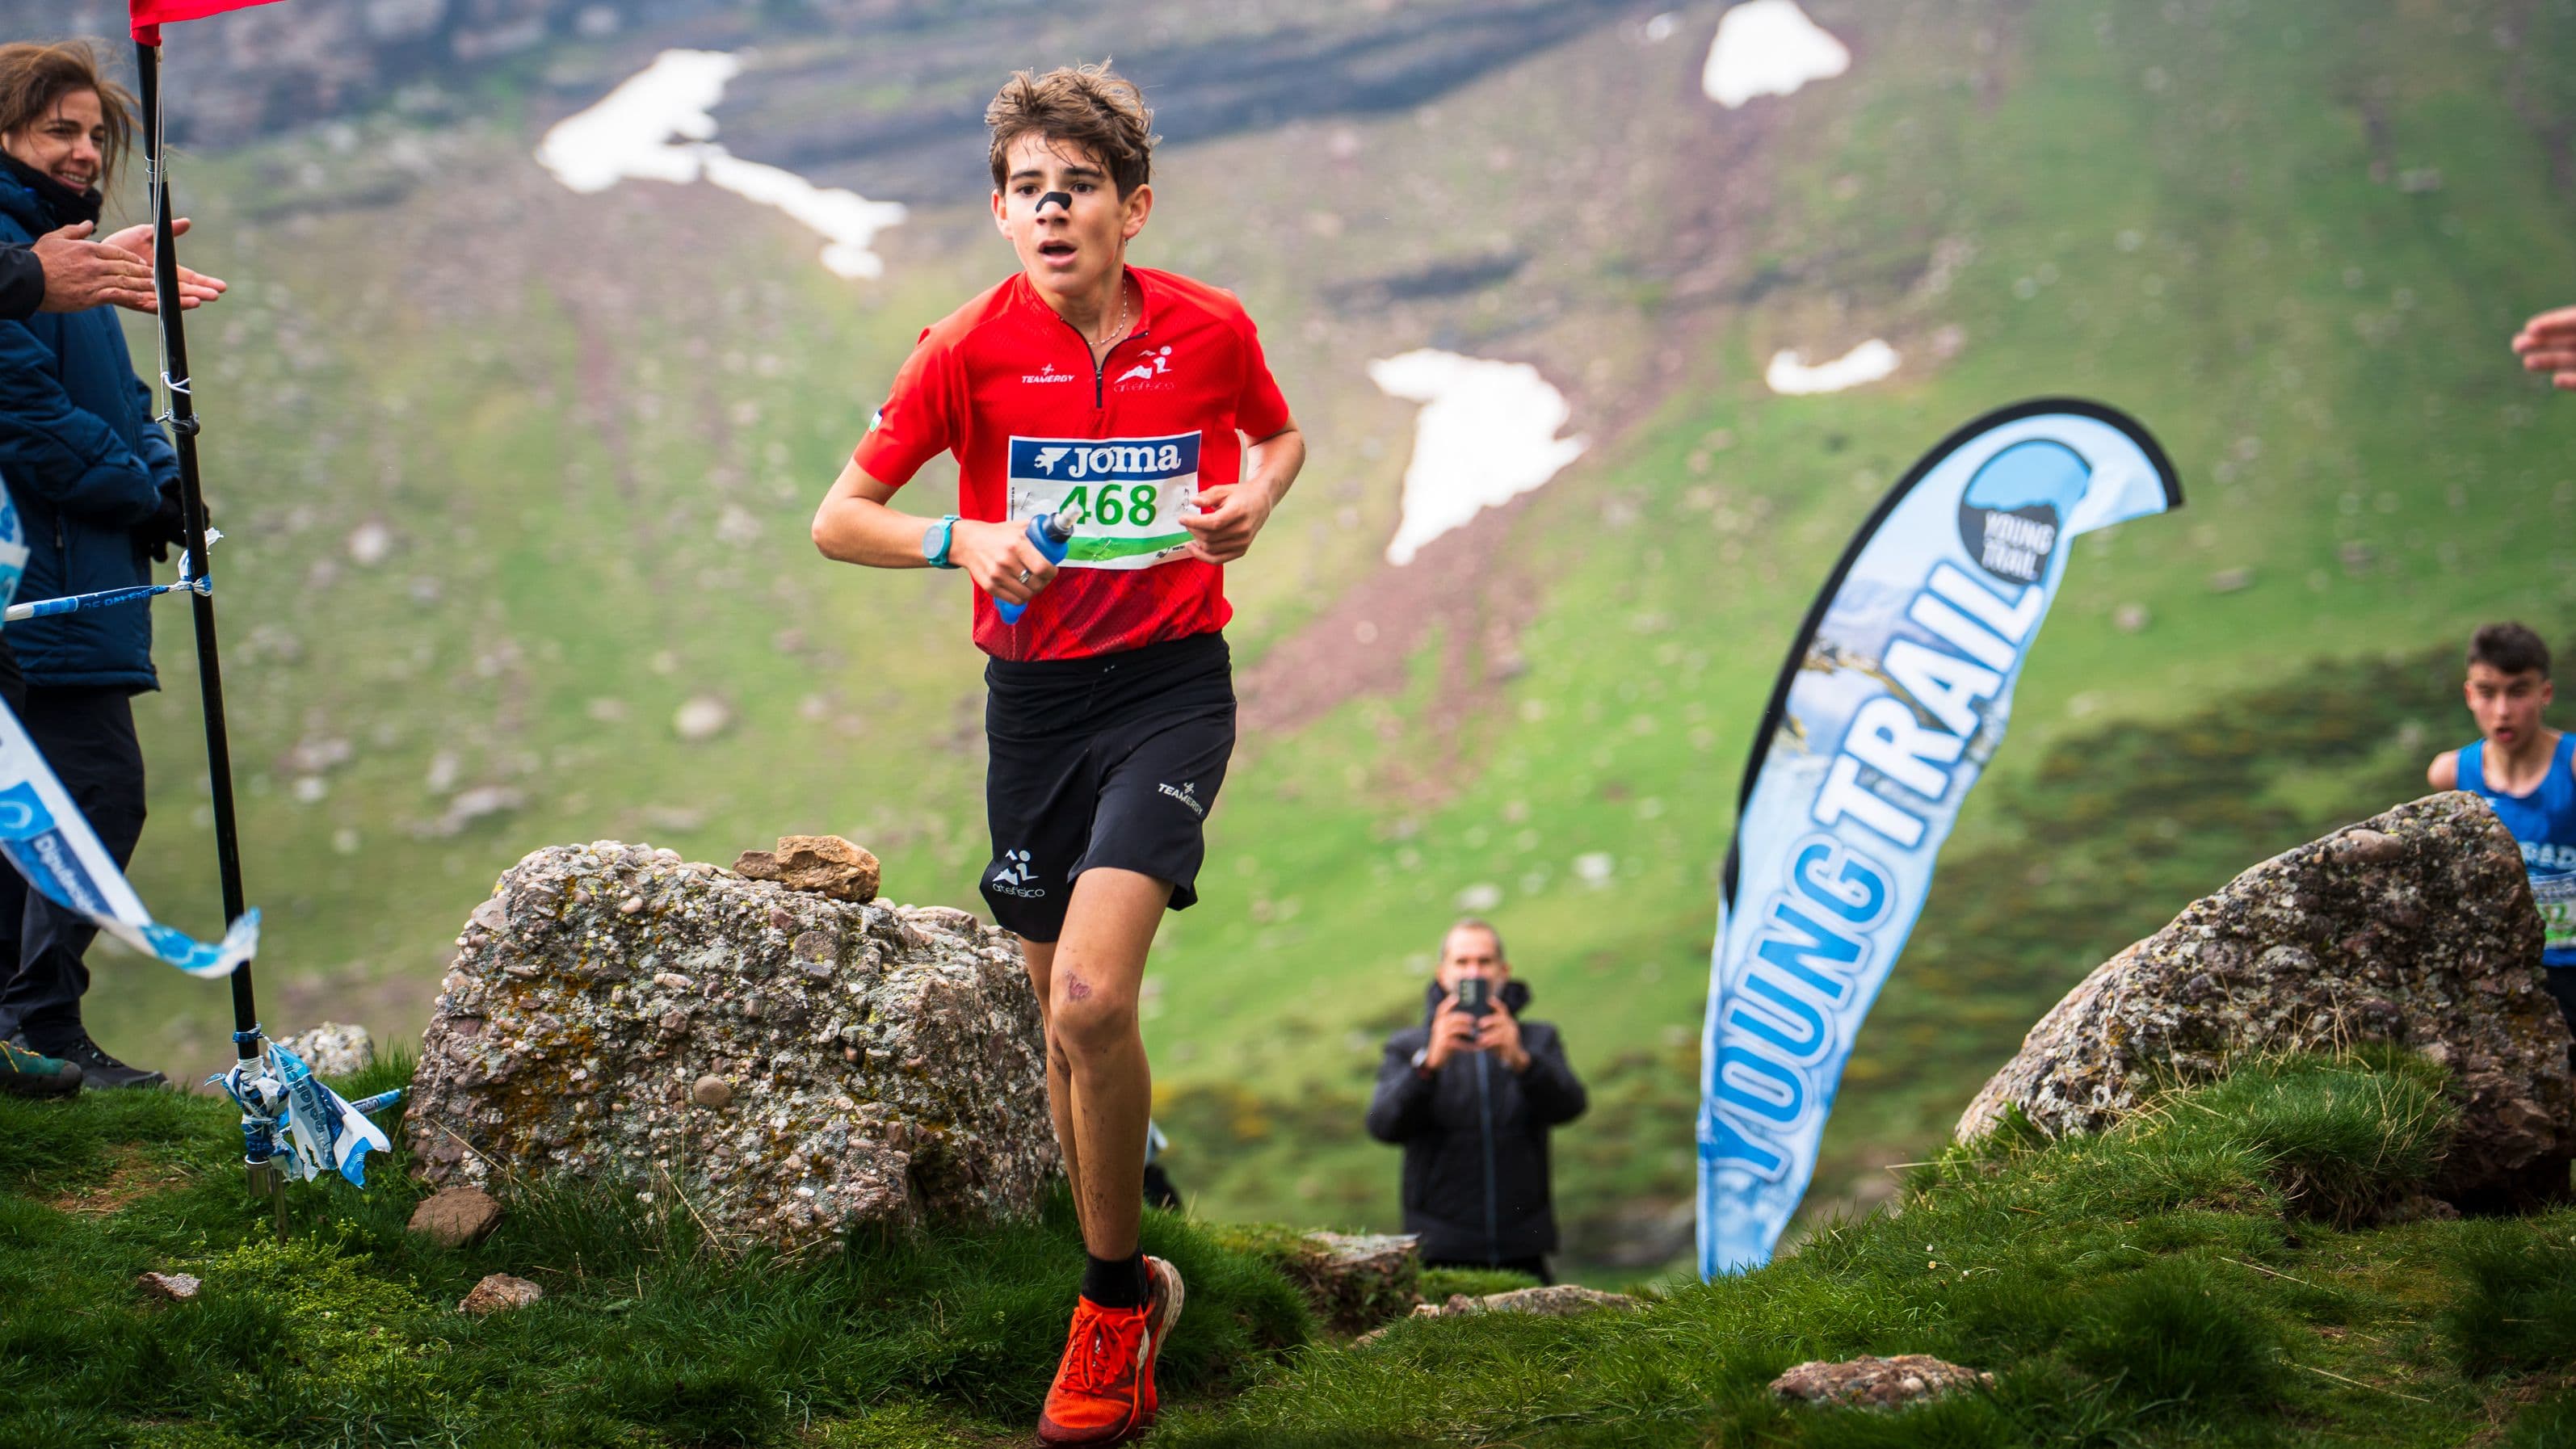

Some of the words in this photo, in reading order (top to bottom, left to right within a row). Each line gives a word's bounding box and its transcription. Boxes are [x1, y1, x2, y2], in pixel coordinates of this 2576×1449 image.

[1059, 484, 1158, 527] 468
[1985, 510, 2056, 555] YOUNG
[1981, 539, 2039, 581] TRAIL
[1699, 838, 1890, 1178] YOUNG
[1813, 561, 2044, 846] TRAIL
